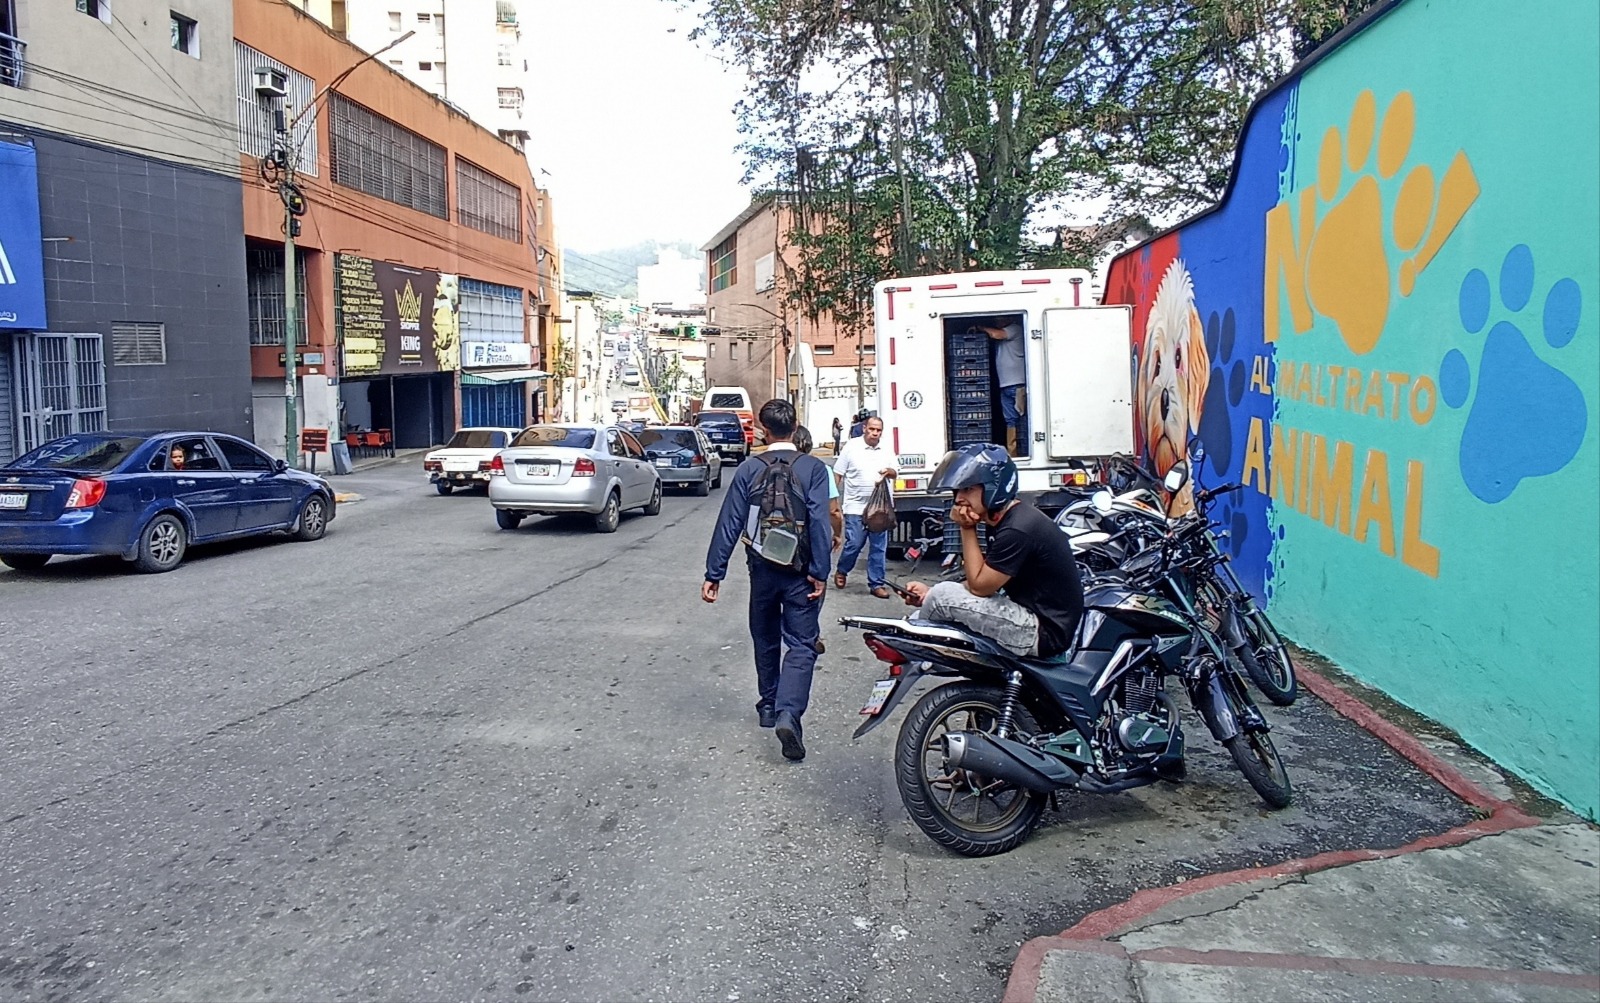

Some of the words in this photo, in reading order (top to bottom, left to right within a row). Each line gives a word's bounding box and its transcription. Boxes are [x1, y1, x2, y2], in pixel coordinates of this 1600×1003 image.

[400, 336, 421, 351] KING
[487, 343, 507, 354] FARMA
[487, 354, 513, 364] REGALOS
[1250, 355, 1272, 396] AL
[1279, 361, 1437, 426] MALTRATO
[1241, 416, 1441, 579] ANIMAL
